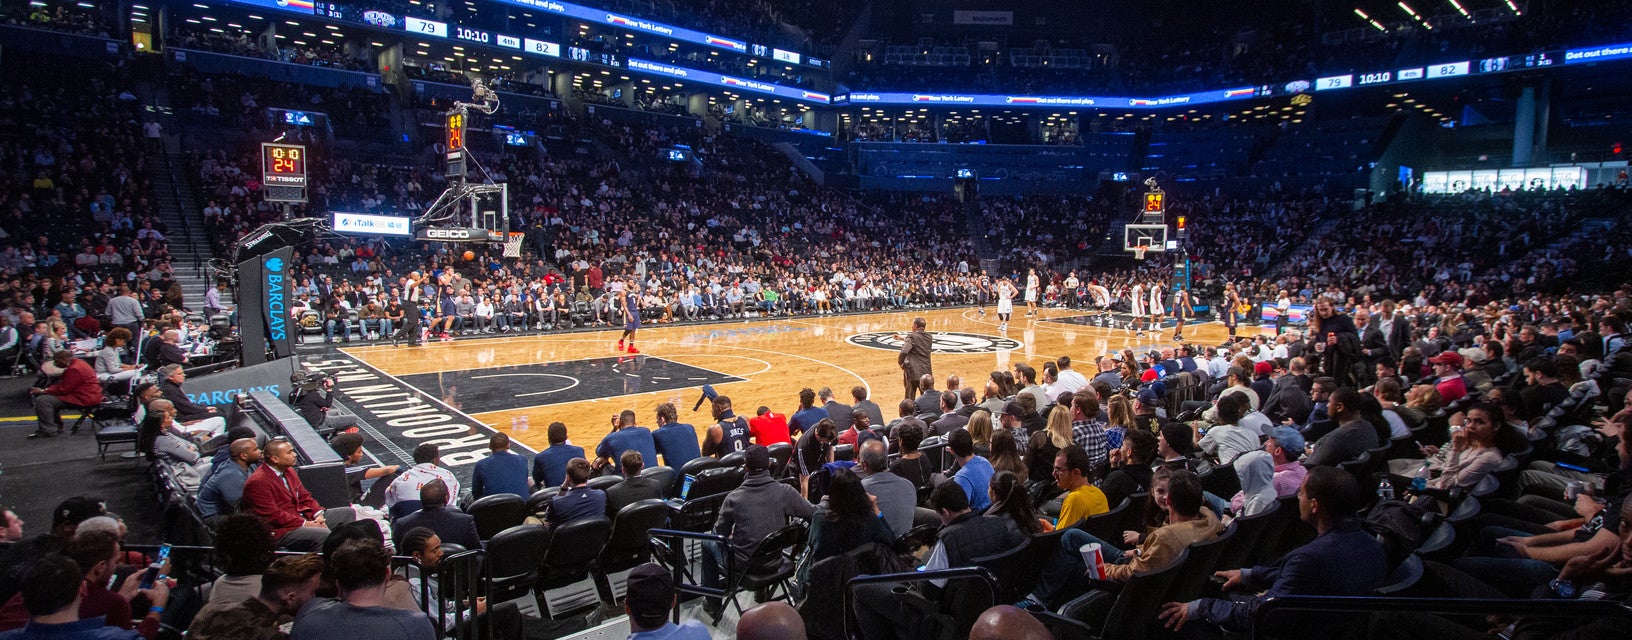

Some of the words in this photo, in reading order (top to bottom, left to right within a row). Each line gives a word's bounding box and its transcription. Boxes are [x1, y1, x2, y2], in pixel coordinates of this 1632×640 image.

[419, 21, 435, 34] 79
[638, 21, 652, 31] York
[456, 27, 489, 43] 10:10
[502, 38, 515, 46] 4th
[535, 42, 550, 54] 82
[1583, 49, 1601, 58] out
[1601, 47, 1629, 56] there
[1440, 65, 1456, 76] 82
[1328, 78, 1342, 88] 79
[1358, 71, 1391, 85] 10:10
[450, 128, 461, 149] 24
[274, 158, 294, 172] 24
[1147, 200, 1160, 211] 24
[426, 229, 470, 239] GEICO
[268, 274, 286, 341] BARCLAYS
